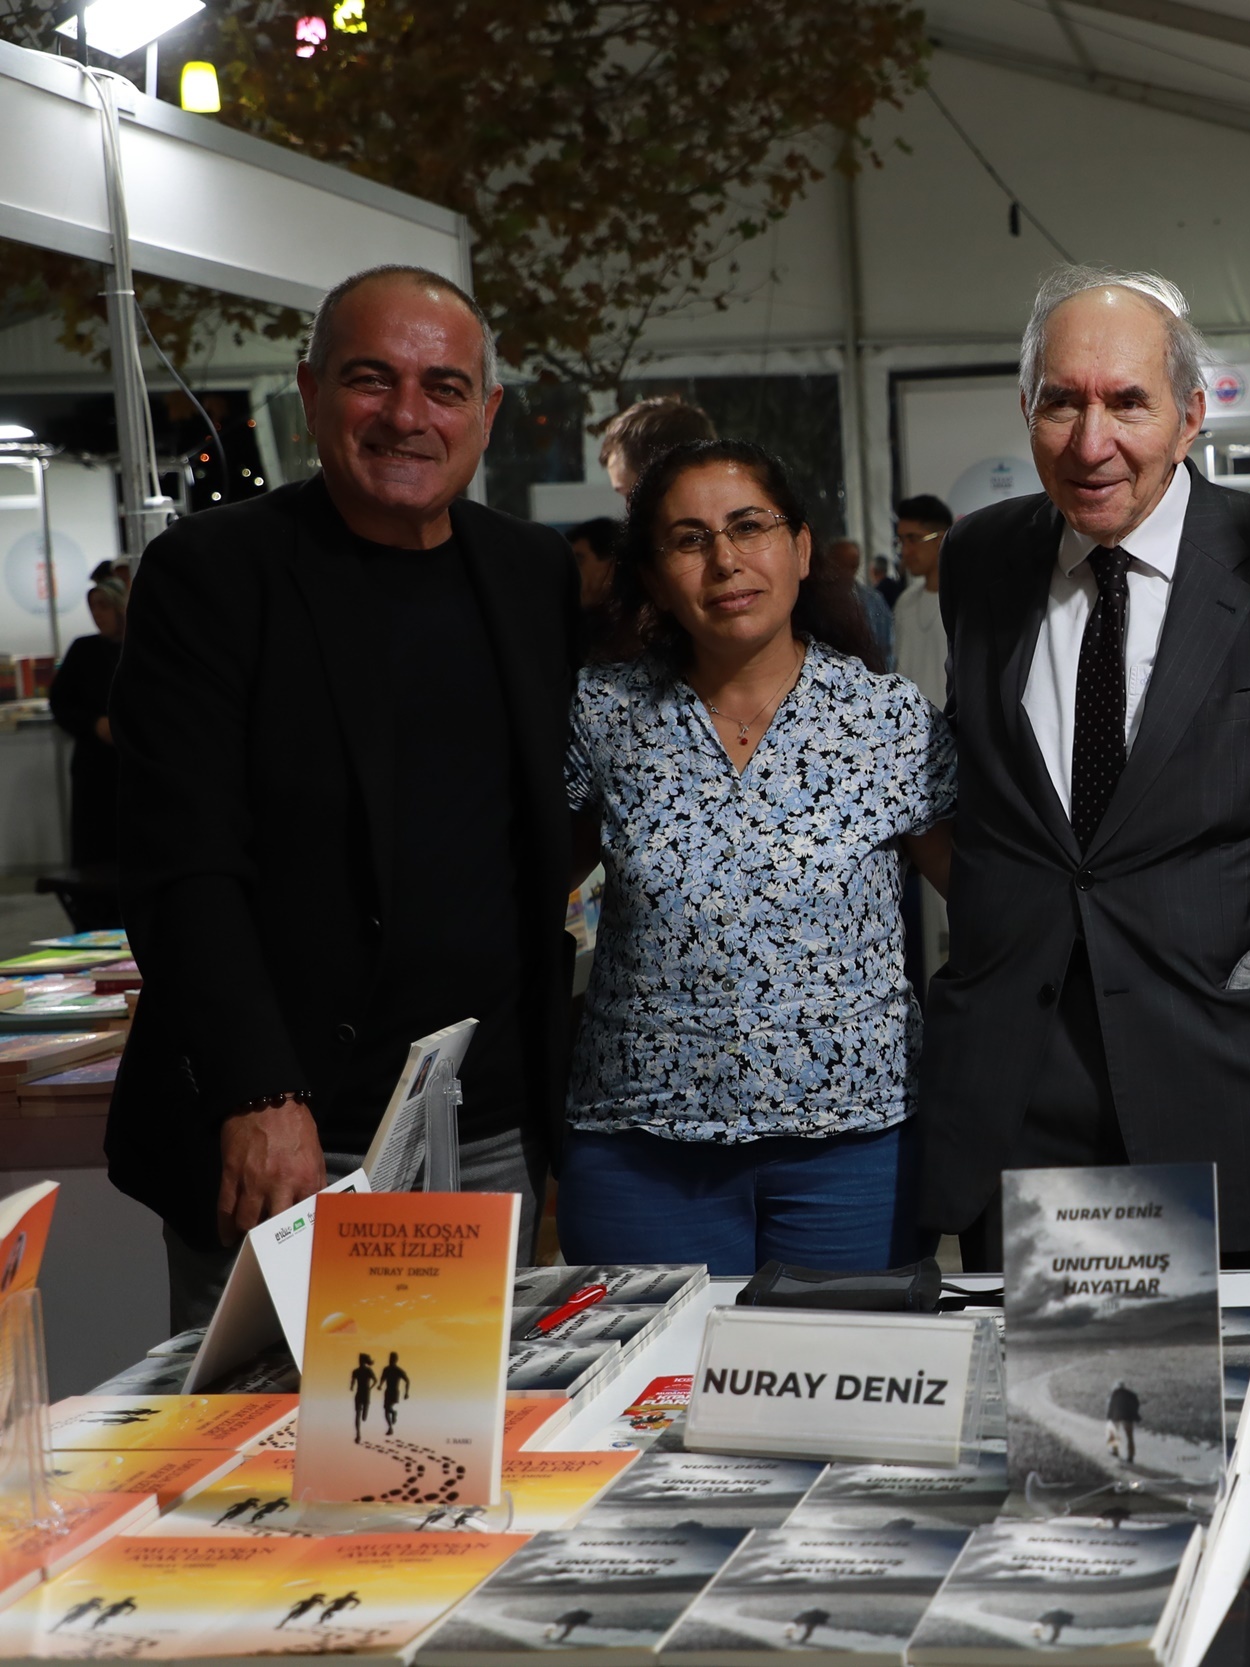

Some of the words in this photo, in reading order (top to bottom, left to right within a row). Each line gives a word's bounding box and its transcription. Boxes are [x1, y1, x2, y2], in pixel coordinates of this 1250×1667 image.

[1056, 1207, 1113, 1221] NURAY
[1115, 1203, 1164, 1219] DENİZ
[338, 1223, 408, 1238] UMUDA
[413, 1223, 481, 1242] KOŞAN
[348, 1242, 396, 1257] AYAK
[401, 1240, 464, 1258] İZLERİ
[368, 1267, 404, 1277] NURAY
[407, 1266, 440, 1277] DENİZ
[1052, 1254, 1170, 1273] UNUTULMUŞ
[1062, 1279, 1161, 1296] HAYATLAR
[702, 1367, 828, 1399] NURAY
[835, 1369, 948, 1405] DENİZ
